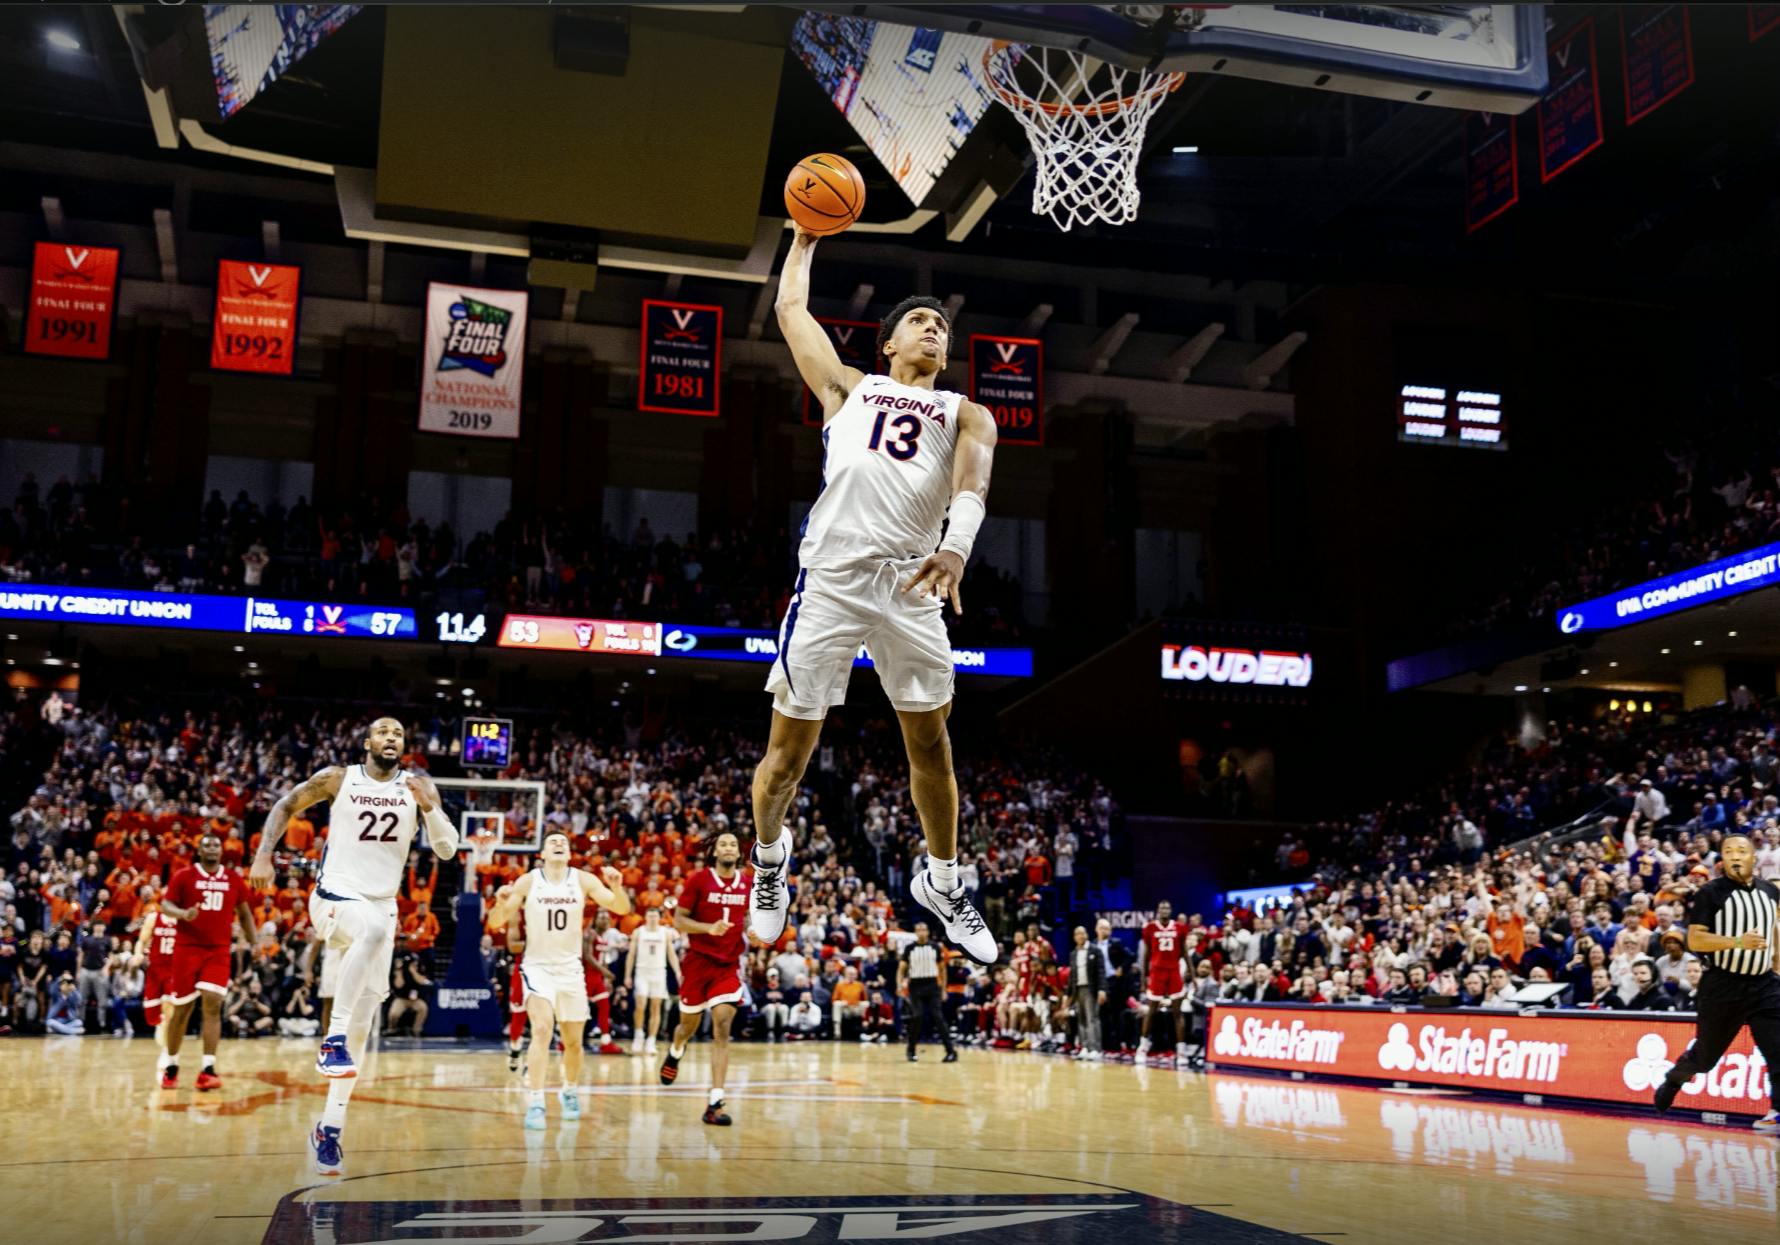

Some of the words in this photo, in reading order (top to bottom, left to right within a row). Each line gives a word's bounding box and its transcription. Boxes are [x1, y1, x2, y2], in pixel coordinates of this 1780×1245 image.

[42, 318, 97, 344] 1991
[453, 319, 503, 339] FINAL
[225, 333, 283, 359] 1992
[447, 335, 501, 356] FOUR
[433, 379, 508, 397] NATIONAL
[655, 373, 704, 398] 1981
[425, 391, 515, 411] CHAMPIONS
[862, 394, 946, 429] VIRGINIA
[447, 410, 493, 430] 2019
[868, 411, 922, 461] 13
[1616, 596, 1643, 617] UVA
[1642, 571, 1724, 609] COMMUNITY
[1724, 555, 1777, 585] CREDIT
[60, 596, 129, 615] CREDIT
[130, 600, 192, 620] UNION
[252, 616, 293, 631] FOULS
[370, 612, 402, 636] 57
[437, 611, 487, 639] 11.4
[509, 620, 540, 644] 53
[745, 637, 779, 655] UVA
[951, 649, 986, 667] ION
[350, 794, 408, 807] VIRGINIA
[358, 810, 399, 842] 22
[200, 890, 224, 911] 30
[536, 896, 578, 905] VIRGINIA
[721, 893, 747, 906] STATE
[547, 909, 567, 931] 10
[723, 907, 730, 923] 1
[159, 936, 176, 955] 12
[450, 988, 491, 1001] UNITED
[450, 999, 480, 1010] BANK
